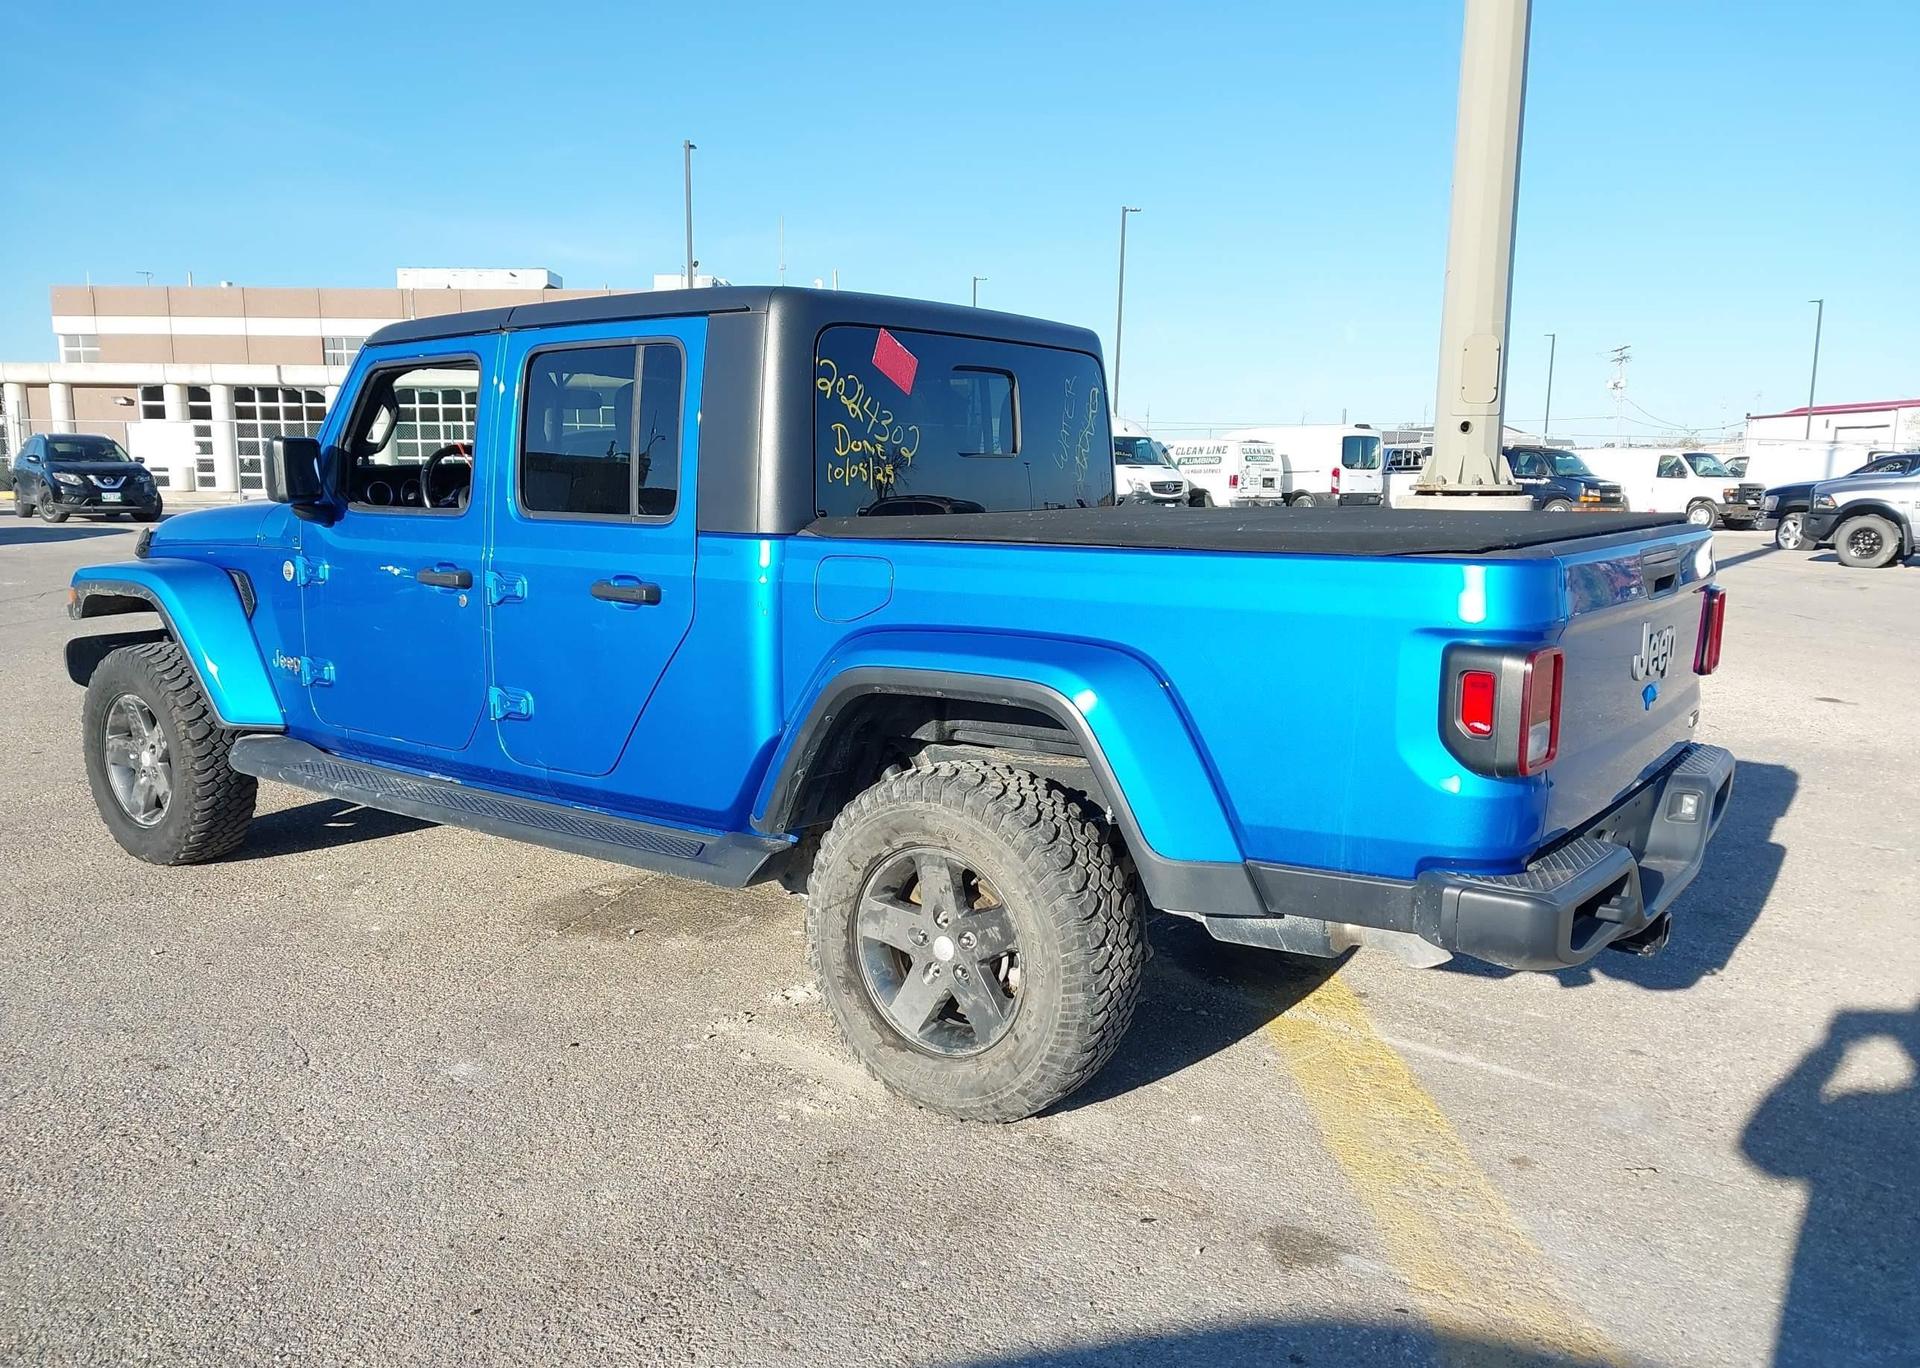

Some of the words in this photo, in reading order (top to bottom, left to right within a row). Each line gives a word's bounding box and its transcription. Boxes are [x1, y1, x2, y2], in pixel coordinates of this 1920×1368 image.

[1175, 446, 1206, 456] CLEAN
[1206, 445, 1229, 455] LINE
[1241, 447, 1262, 456] CLEAN
[1180, 456, 1221, 465] PLUMBING
[1631, 622, 1676, 681] Jeep
[272, 648, 301, 676] Jeep
